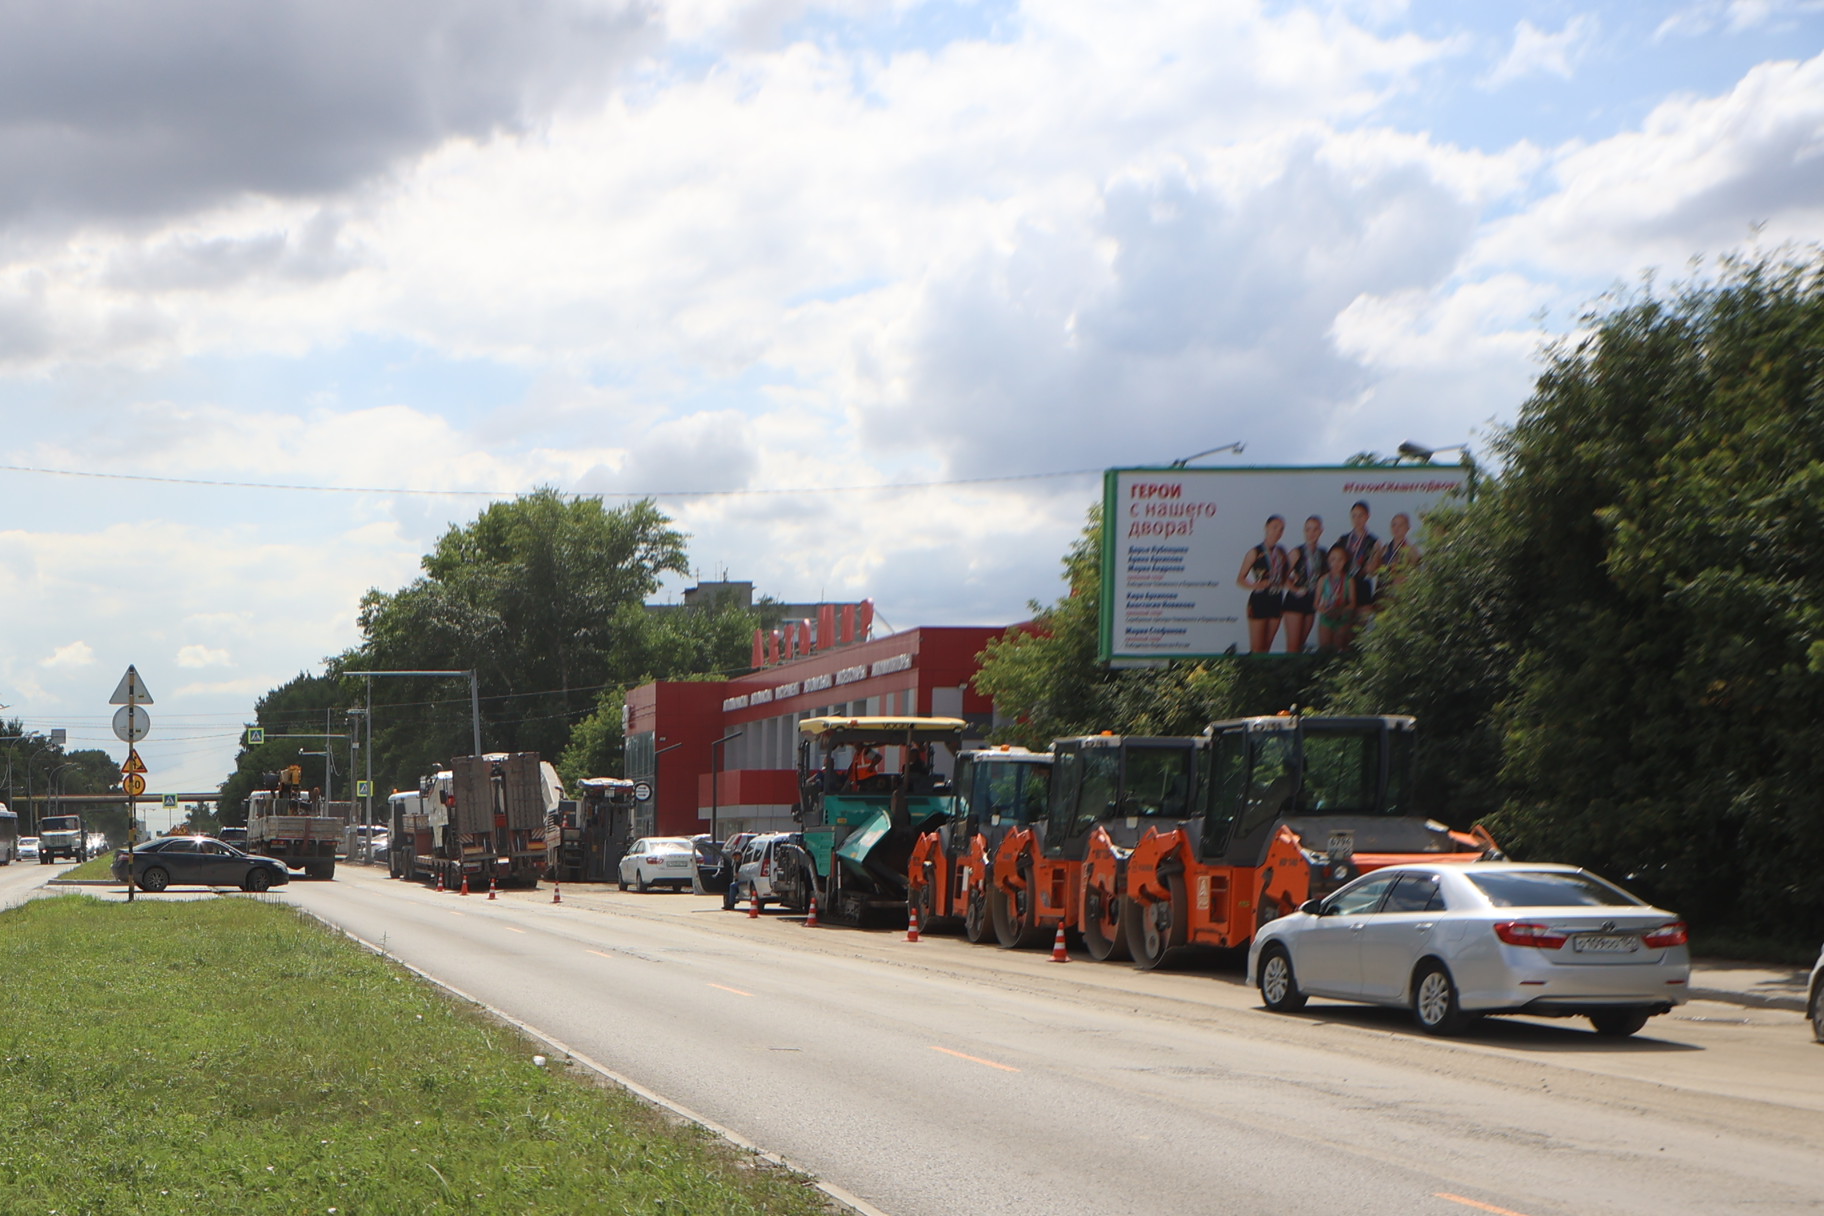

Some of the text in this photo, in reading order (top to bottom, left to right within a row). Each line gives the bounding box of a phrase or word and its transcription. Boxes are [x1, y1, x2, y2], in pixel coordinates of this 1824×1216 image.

[1130, 483, 1182, 499] ГЕРОИ
[1144, 502, 1217, 519] нашего
[1128, 518, 1195, 540] двора!
